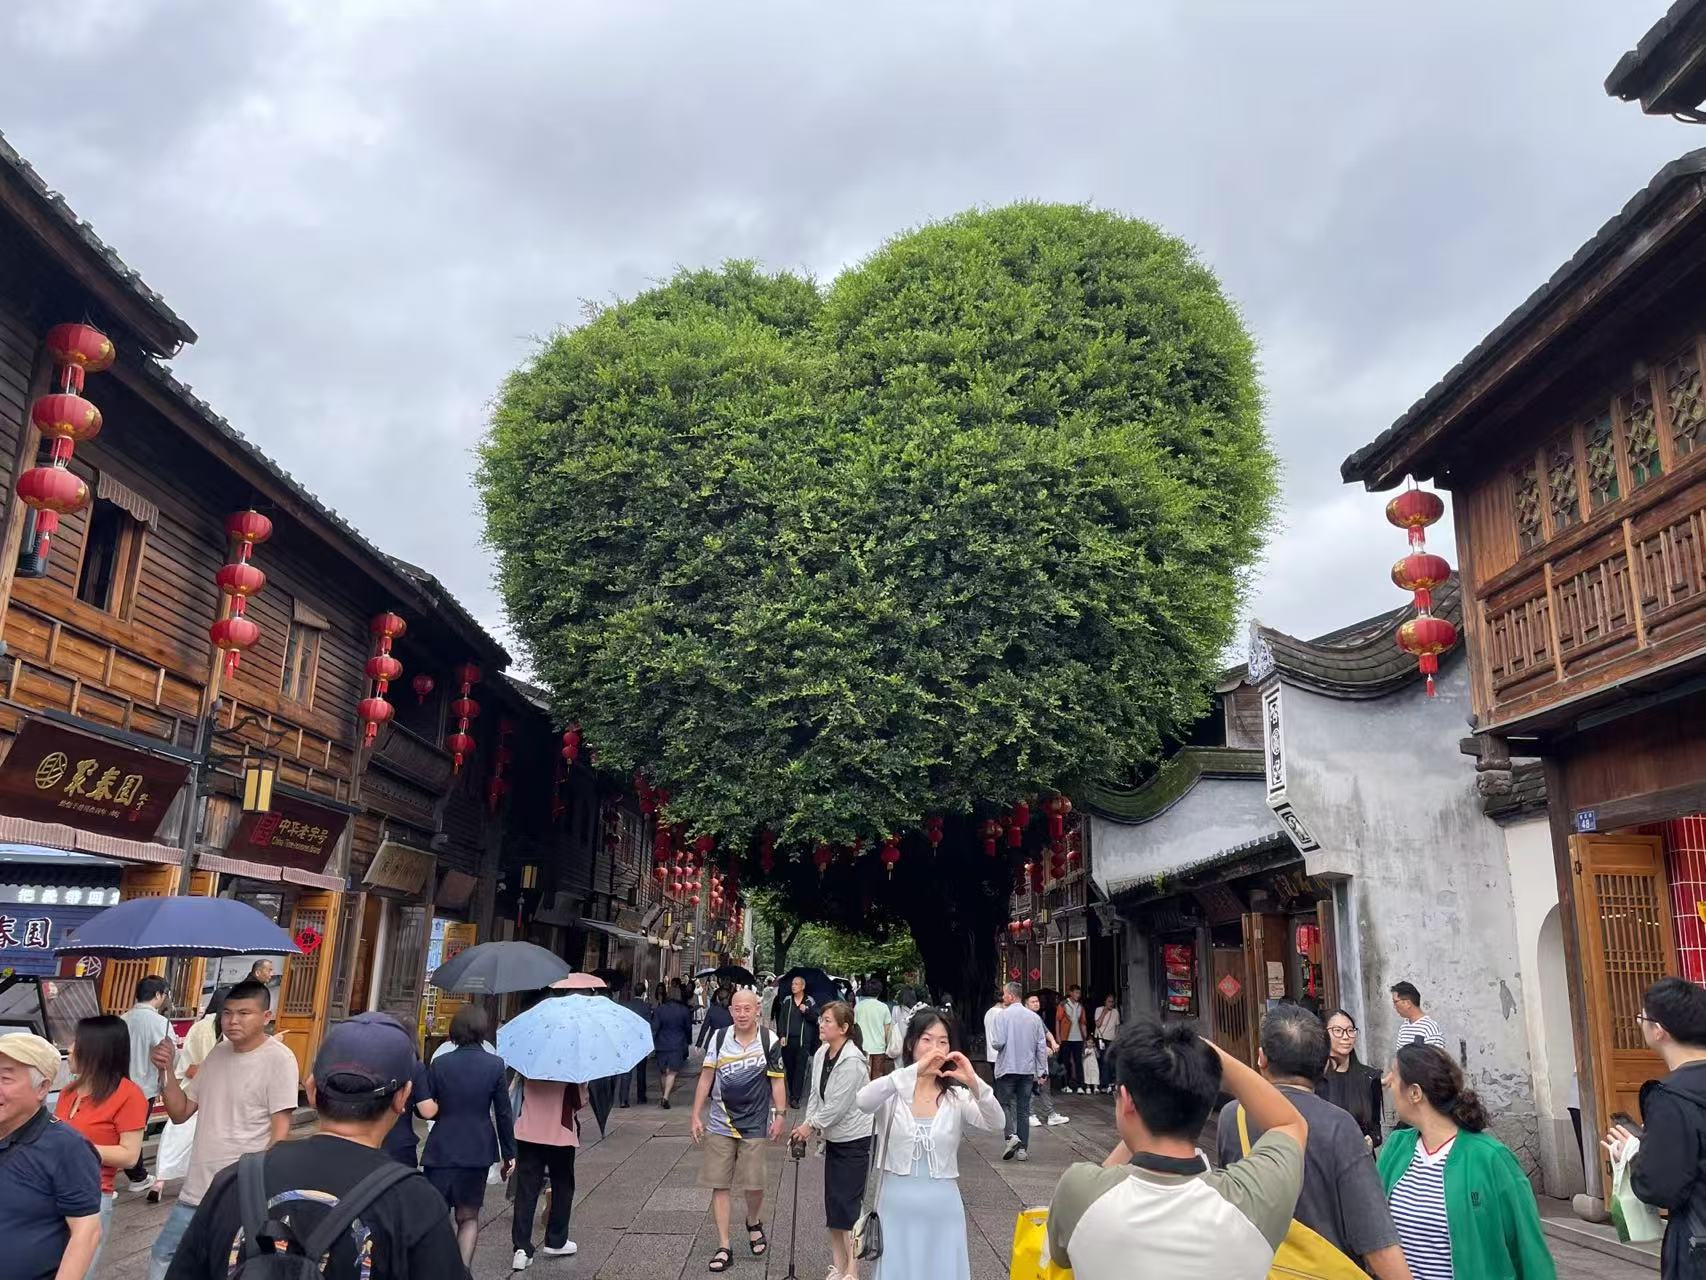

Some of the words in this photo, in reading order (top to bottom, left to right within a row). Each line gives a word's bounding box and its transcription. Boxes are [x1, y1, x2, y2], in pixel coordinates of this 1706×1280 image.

[279, 819, 329, 844] 中华老字号
